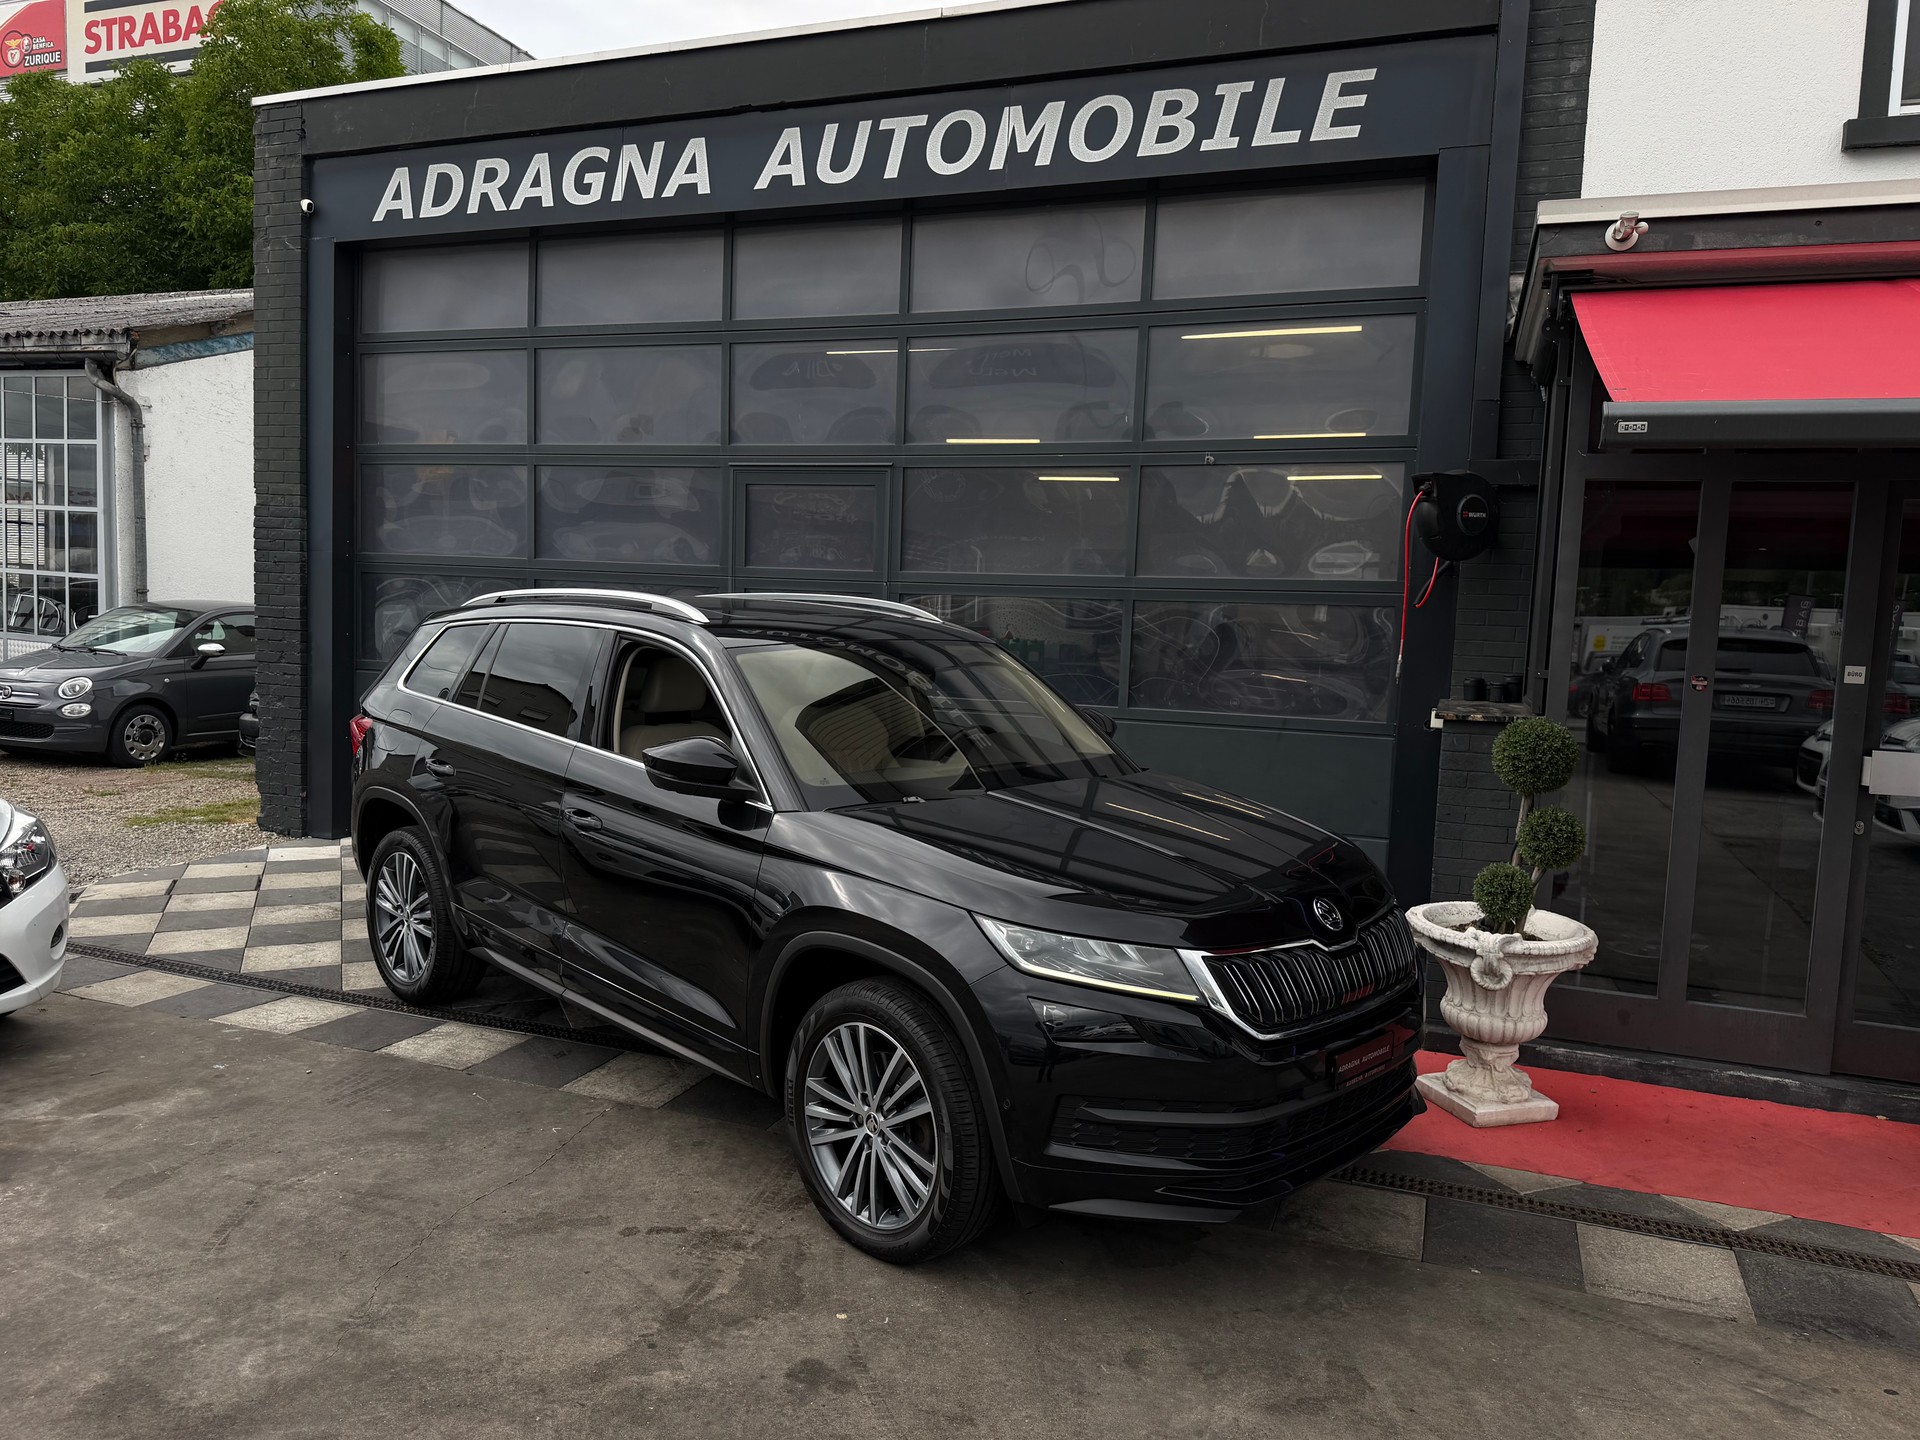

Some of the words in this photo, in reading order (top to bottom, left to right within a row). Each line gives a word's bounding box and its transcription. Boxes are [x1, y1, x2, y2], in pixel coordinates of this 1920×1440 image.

[32, 36, 46, 44] CASA
[32, 41, 54, 50] BENFICA
[24, 51, 61, 67] ZURIQUE
[372, 136, 711, 222] ADRAGNA
[754, 68, 1377, 190] AUTOMOBILE
[1338, 1058, 1360, 1073] ADRAGNA
[1362, 1045, 1389, 1063] AUTOMOBILE
